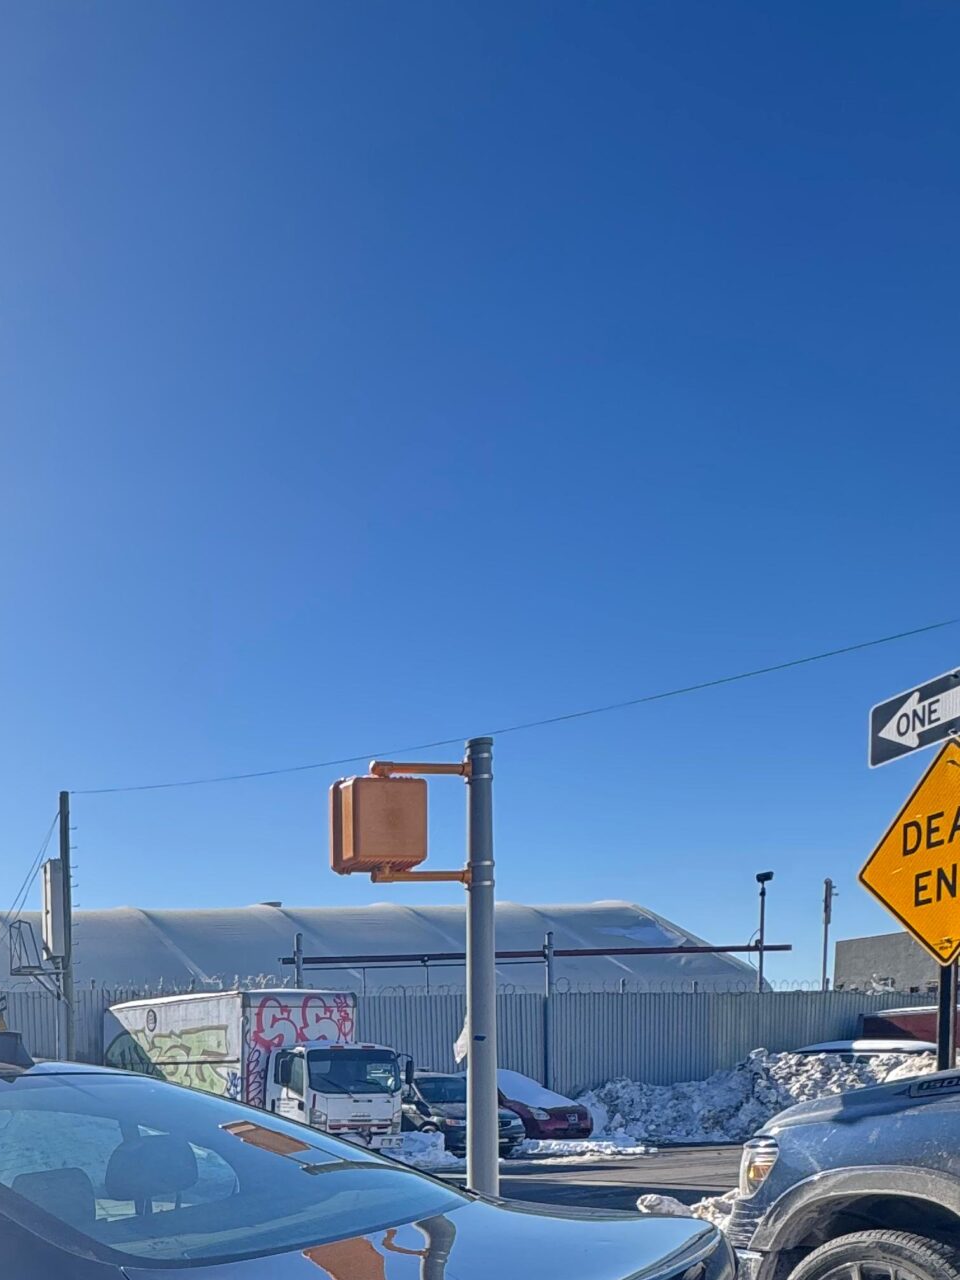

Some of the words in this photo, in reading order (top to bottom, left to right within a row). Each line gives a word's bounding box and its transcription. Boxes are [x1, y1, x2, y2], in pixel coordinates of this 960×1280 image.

[896, 699, 941, 737] ONE
[902, 806, 960, 857] DEA
[914, 863, 958, 907] EN
